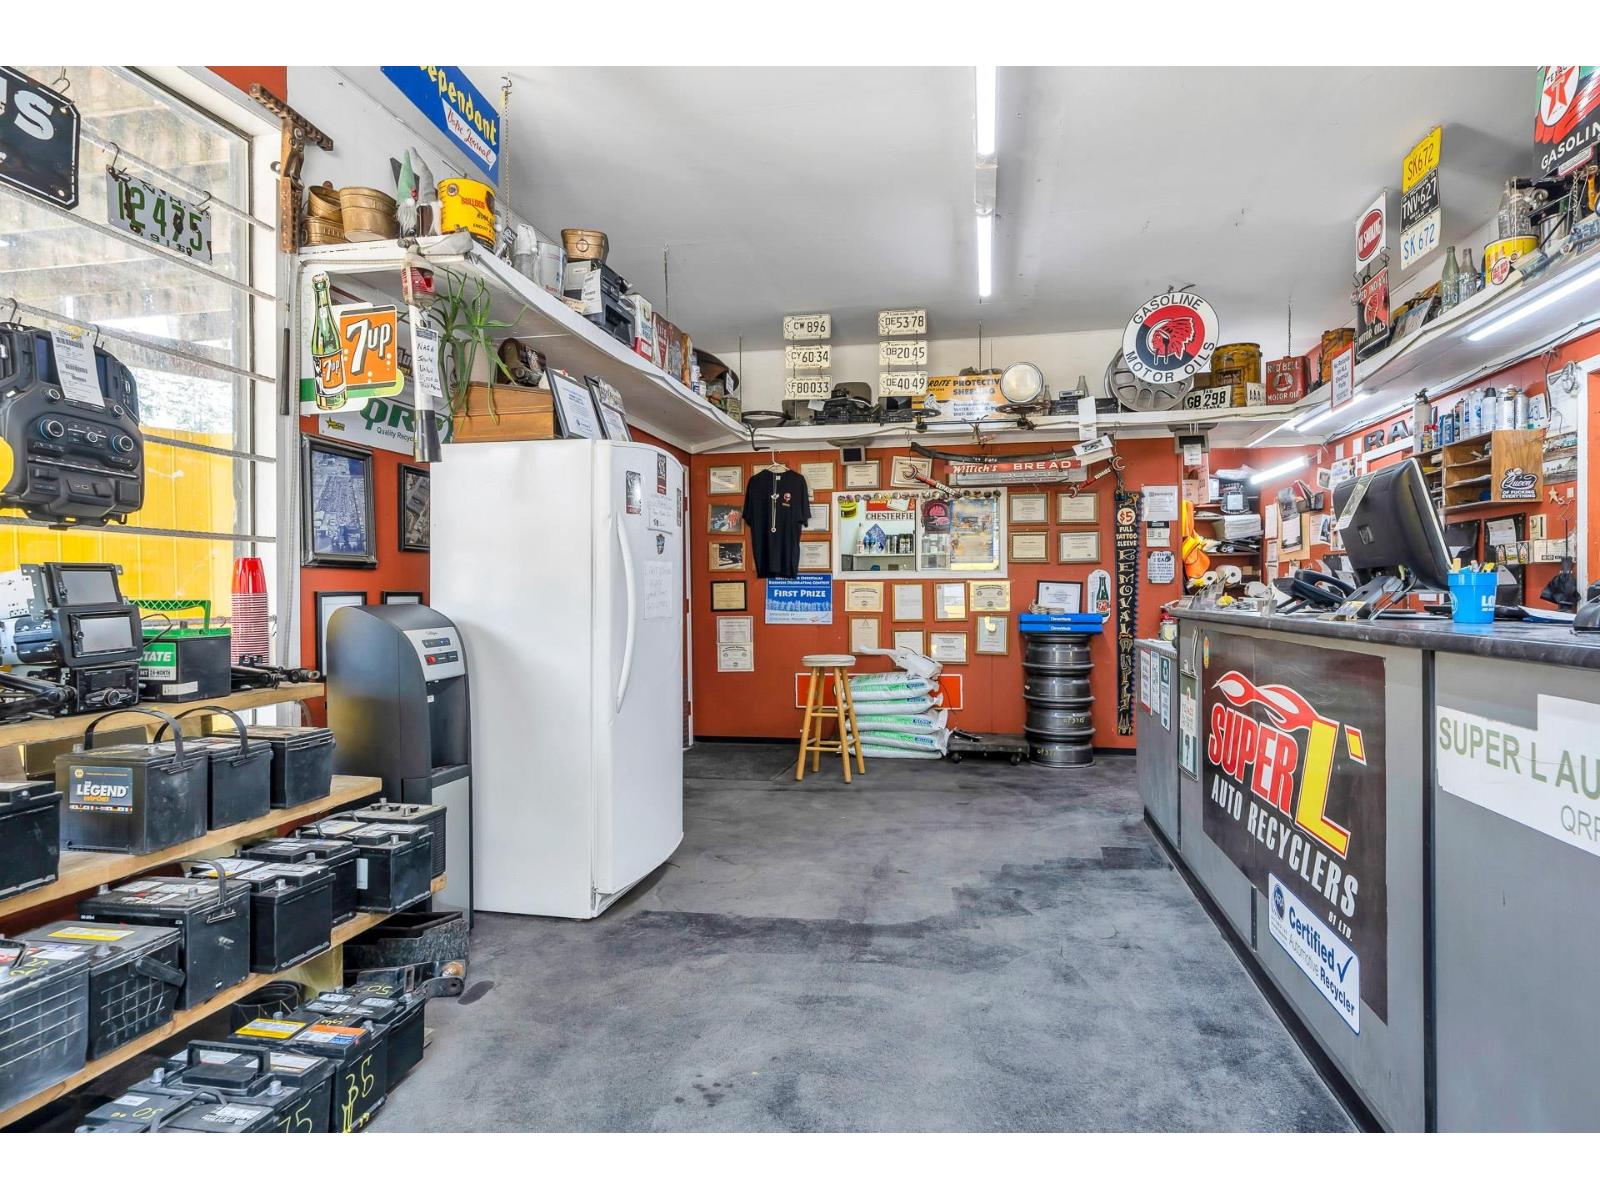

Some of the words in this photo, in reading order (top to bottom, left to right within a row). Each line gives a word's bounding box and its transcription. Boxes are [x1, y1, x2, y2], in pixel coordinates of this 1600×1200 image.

[1133, 294, 1204, 325] GASOLINE
[1125, 350, 1174, 382] MOTOR
[1184, 341, 1215, 375] OILS
[1013, 460, 1072, 470] BREAD
[774, 589, 798, 597] FIRST
[800, 589, 826, 598] PRIZE
[1208, 701, 1299, 819] SUPER
[1439, 716, 1521, 775] SUPER
[76, 784, 128, 798] LEGEND
[1211, 774, 1242, 821] AUTO
[1246, 806, 1359, 919] RECYCLERS
[1288, 905, 1335, 972] Certified
[1320, 965, 1355, 1017] Recycler
